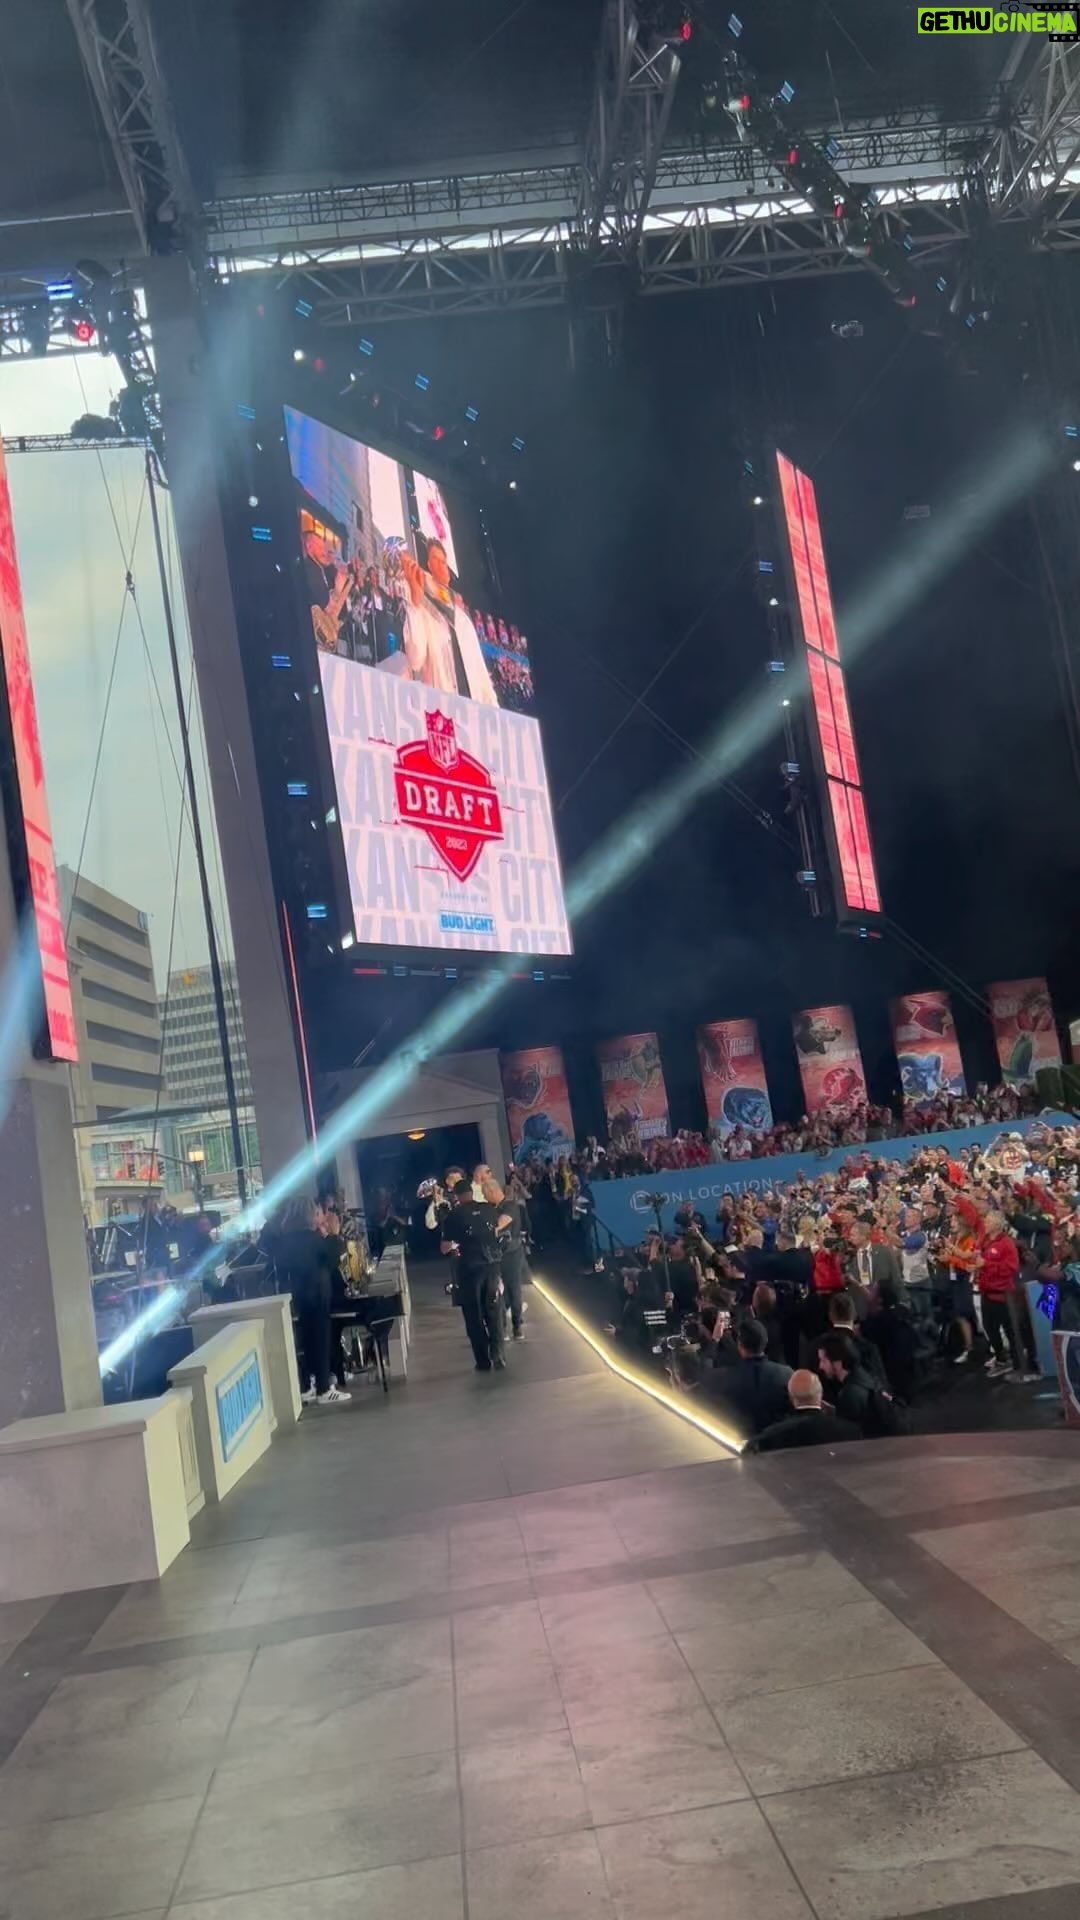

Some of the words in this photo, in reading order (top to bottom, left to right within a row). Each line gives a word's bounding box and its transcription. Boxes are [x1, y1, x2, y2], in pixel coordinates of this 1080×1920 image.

[320, 657, 472, 750] ANSS
[431, 732, 457, 765] NFL
[403, 780, 493, 826] DRAFT
[346, 828, 491, 914] ANSS
[441, 914, 464, 929] BUD
[464, 916, 493, 932] LIGHT
[689, 1176, 773, 1202] LOCATION
